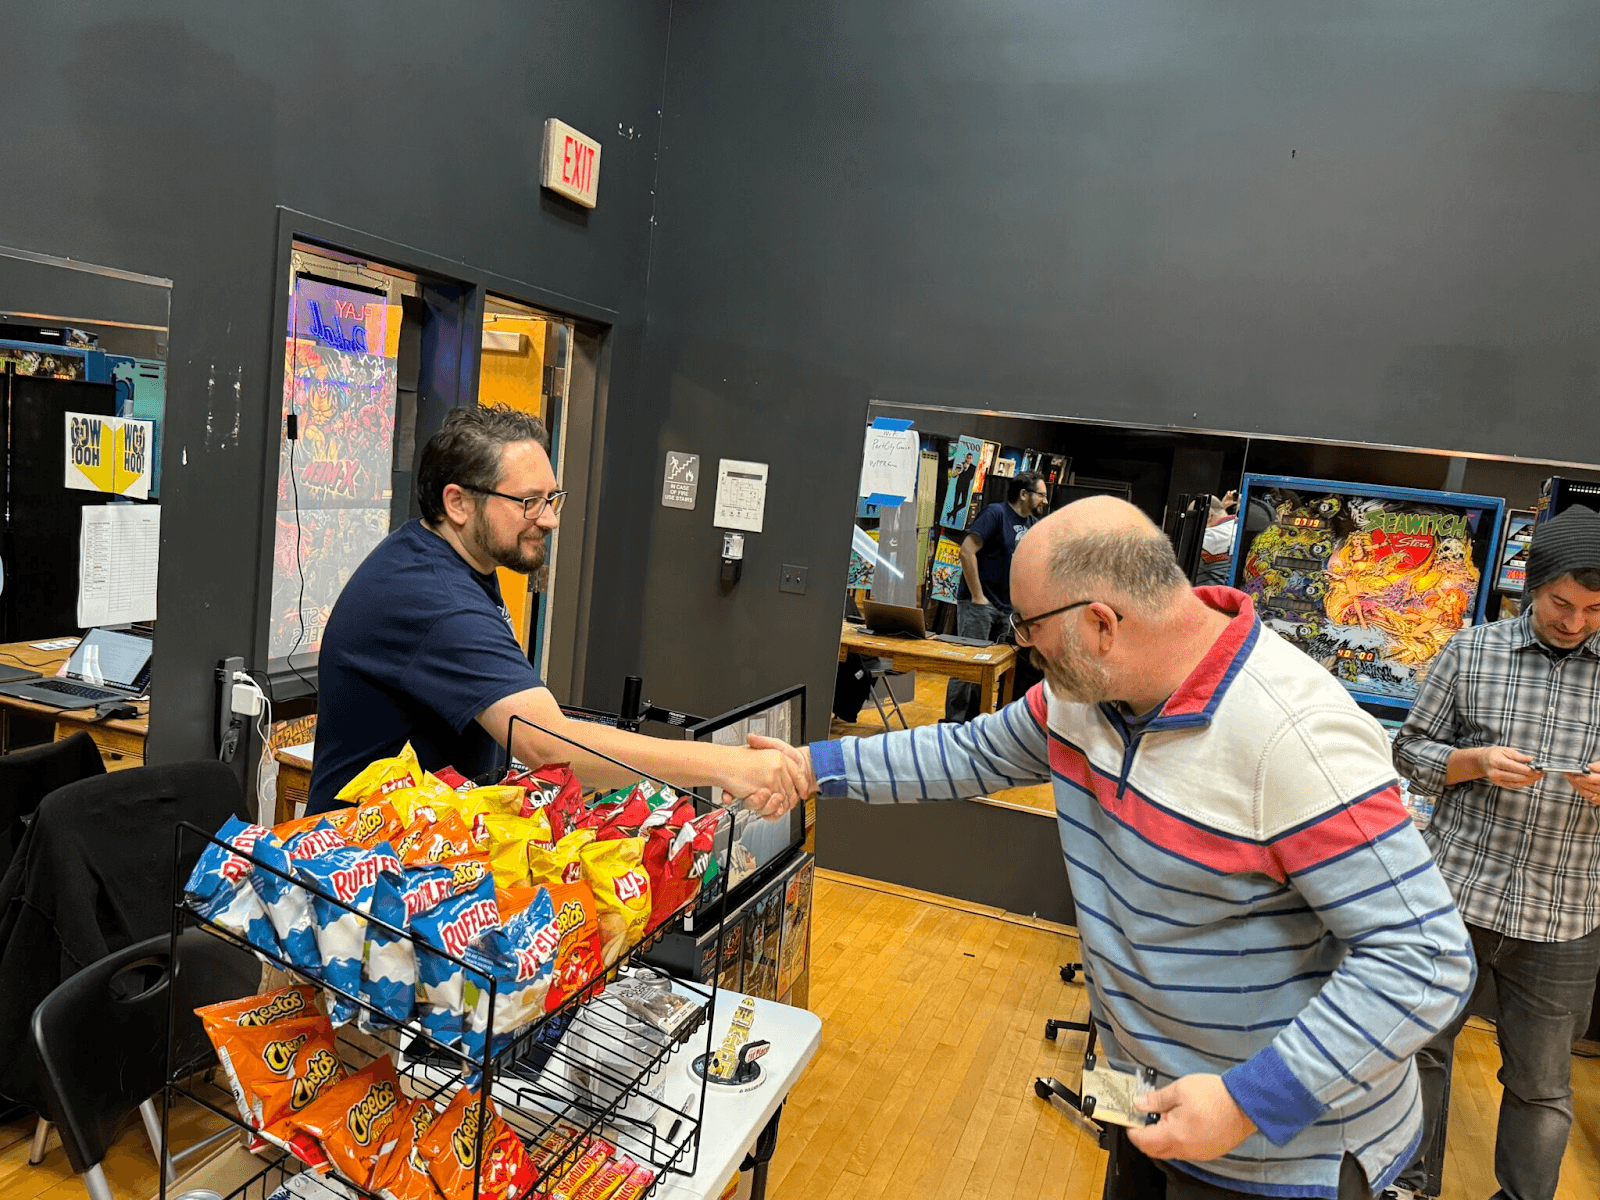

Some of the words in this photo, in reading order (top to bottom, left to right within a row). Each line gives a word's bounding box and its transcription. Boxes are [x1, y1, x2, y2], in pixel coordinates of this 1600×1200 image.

[562, 134, 595, 195] EXIT
[675, 495, 693, 503] STAIRS
[1362, 508, 1468, 538] SEAWITCH
[1395, 537, 1431, 549] Stern
[441, 900, 500, 957] RUFFLES
[348, 1082, 395, 1146] Cheetos
